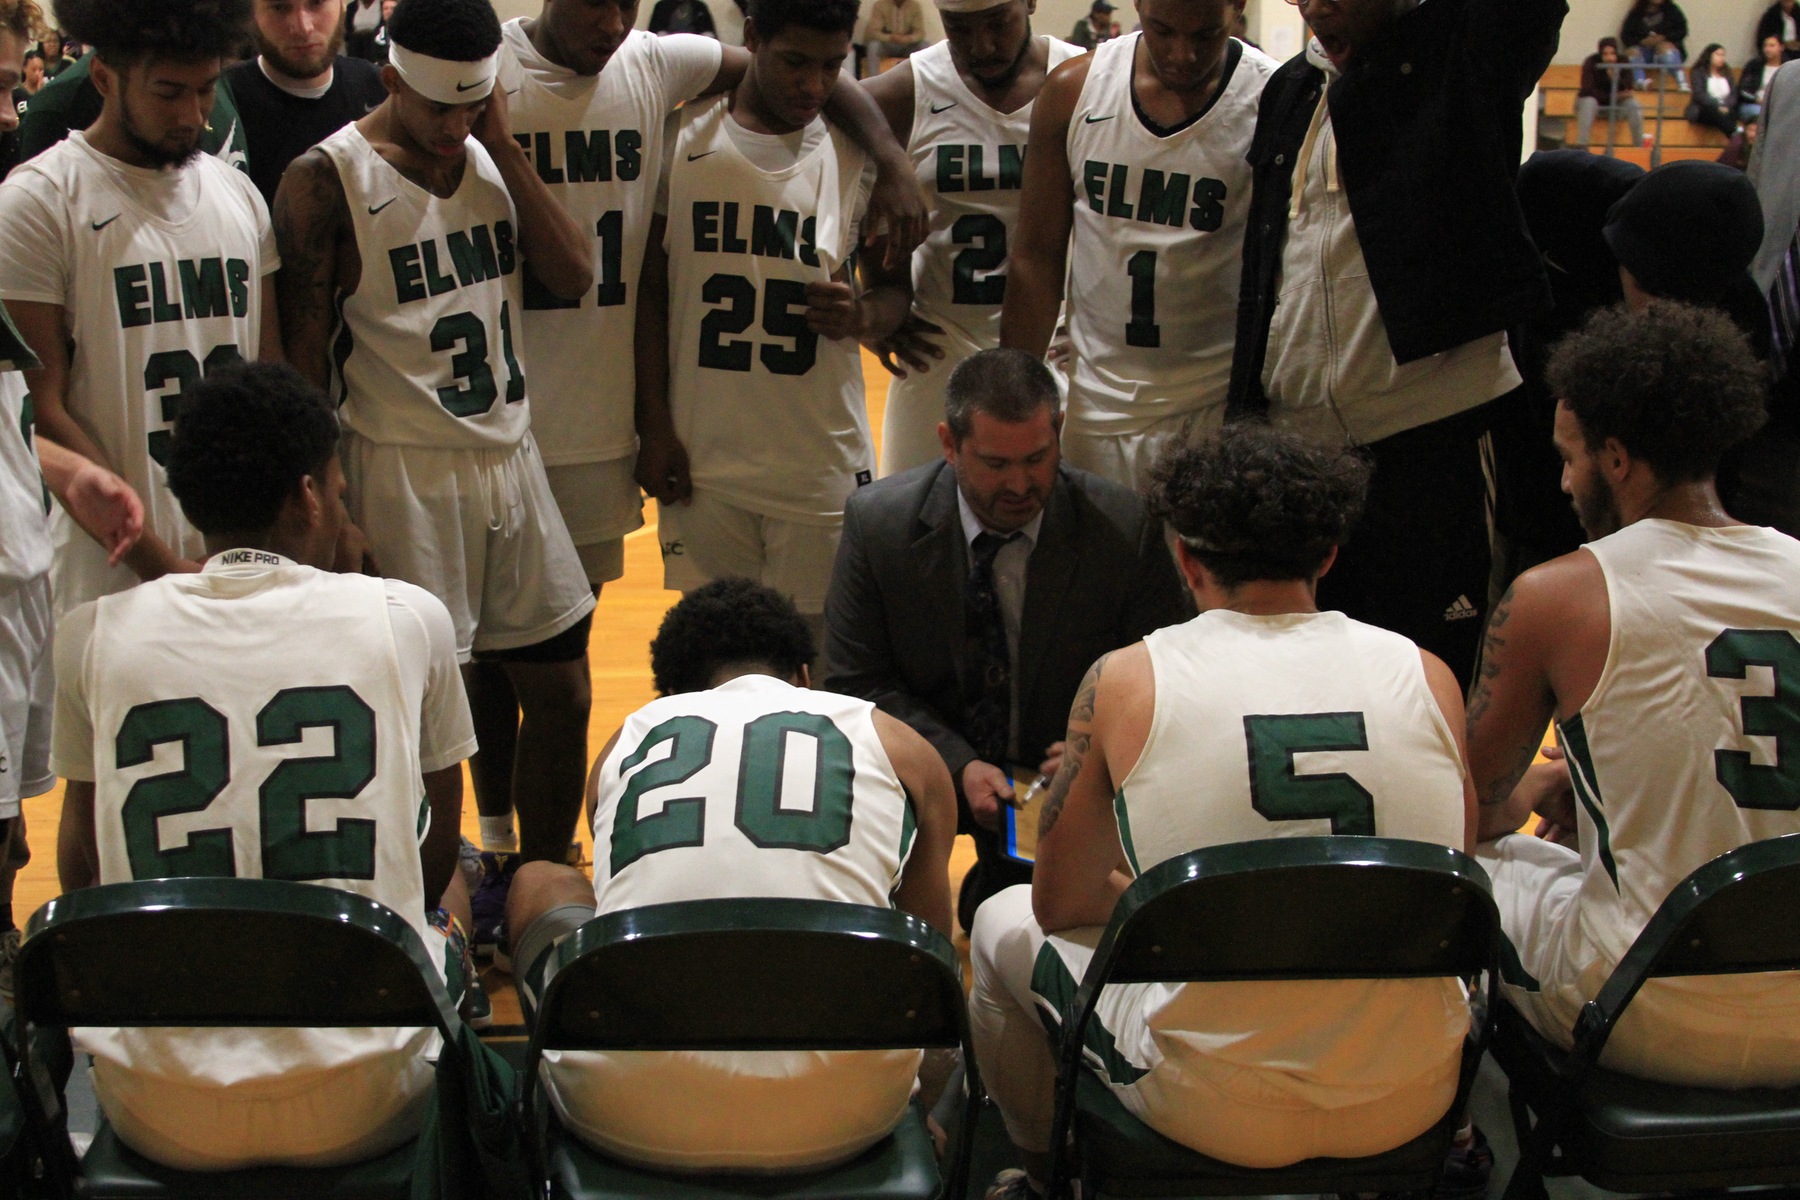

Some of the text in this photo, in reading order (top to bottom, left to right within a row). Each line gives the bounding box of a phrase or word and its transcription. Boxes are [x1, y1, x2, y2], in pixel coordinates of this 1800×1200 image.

[513, 130, 641, 184] LMS
[936, 144, 1028, 192] ELM
[1084, 160, 1227, 232] ELMS
[114, 257, 249, 328] ELMS
[388, 220, 515, 304] ELMS
[522, 210, 626, 310] 1
[1125, 250, 1160, 347] 1
[430, 300, 524, 417] 31
[698, 273, 819, 376] 25
[144, 344, 246, 467] 3
[222, 551, 279, 565] NIKE PRO
[1704, 628, 1800, 811] 3
[115, 685, 376, 880] 22
[610, 710, 854, 878] 20
[1243, 711, 1377, 836] 5
